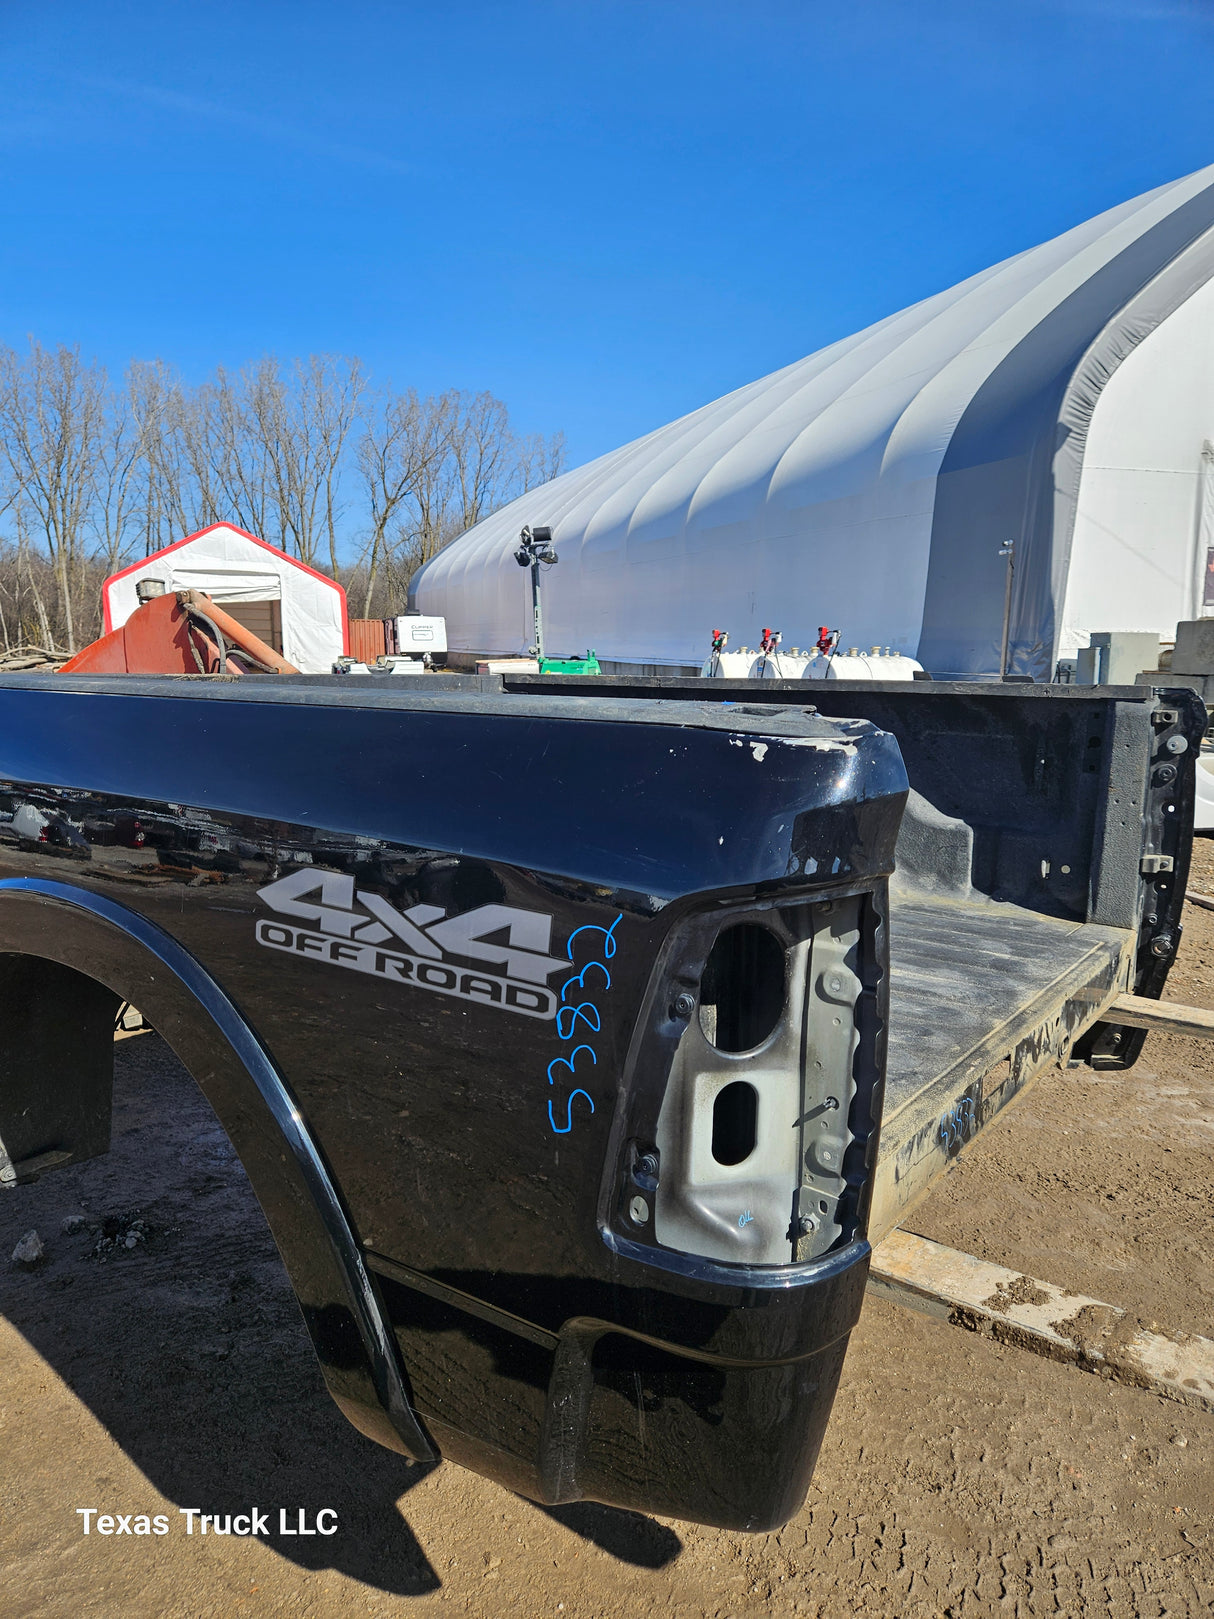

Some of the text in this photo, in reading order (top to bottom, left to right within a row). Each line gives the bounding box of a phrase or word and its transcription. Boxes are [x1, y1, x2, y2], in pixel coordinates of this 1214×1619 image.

[261, 926, 550, 1013] OFF ROAD
[547, 913, 623, 1134] 53832
